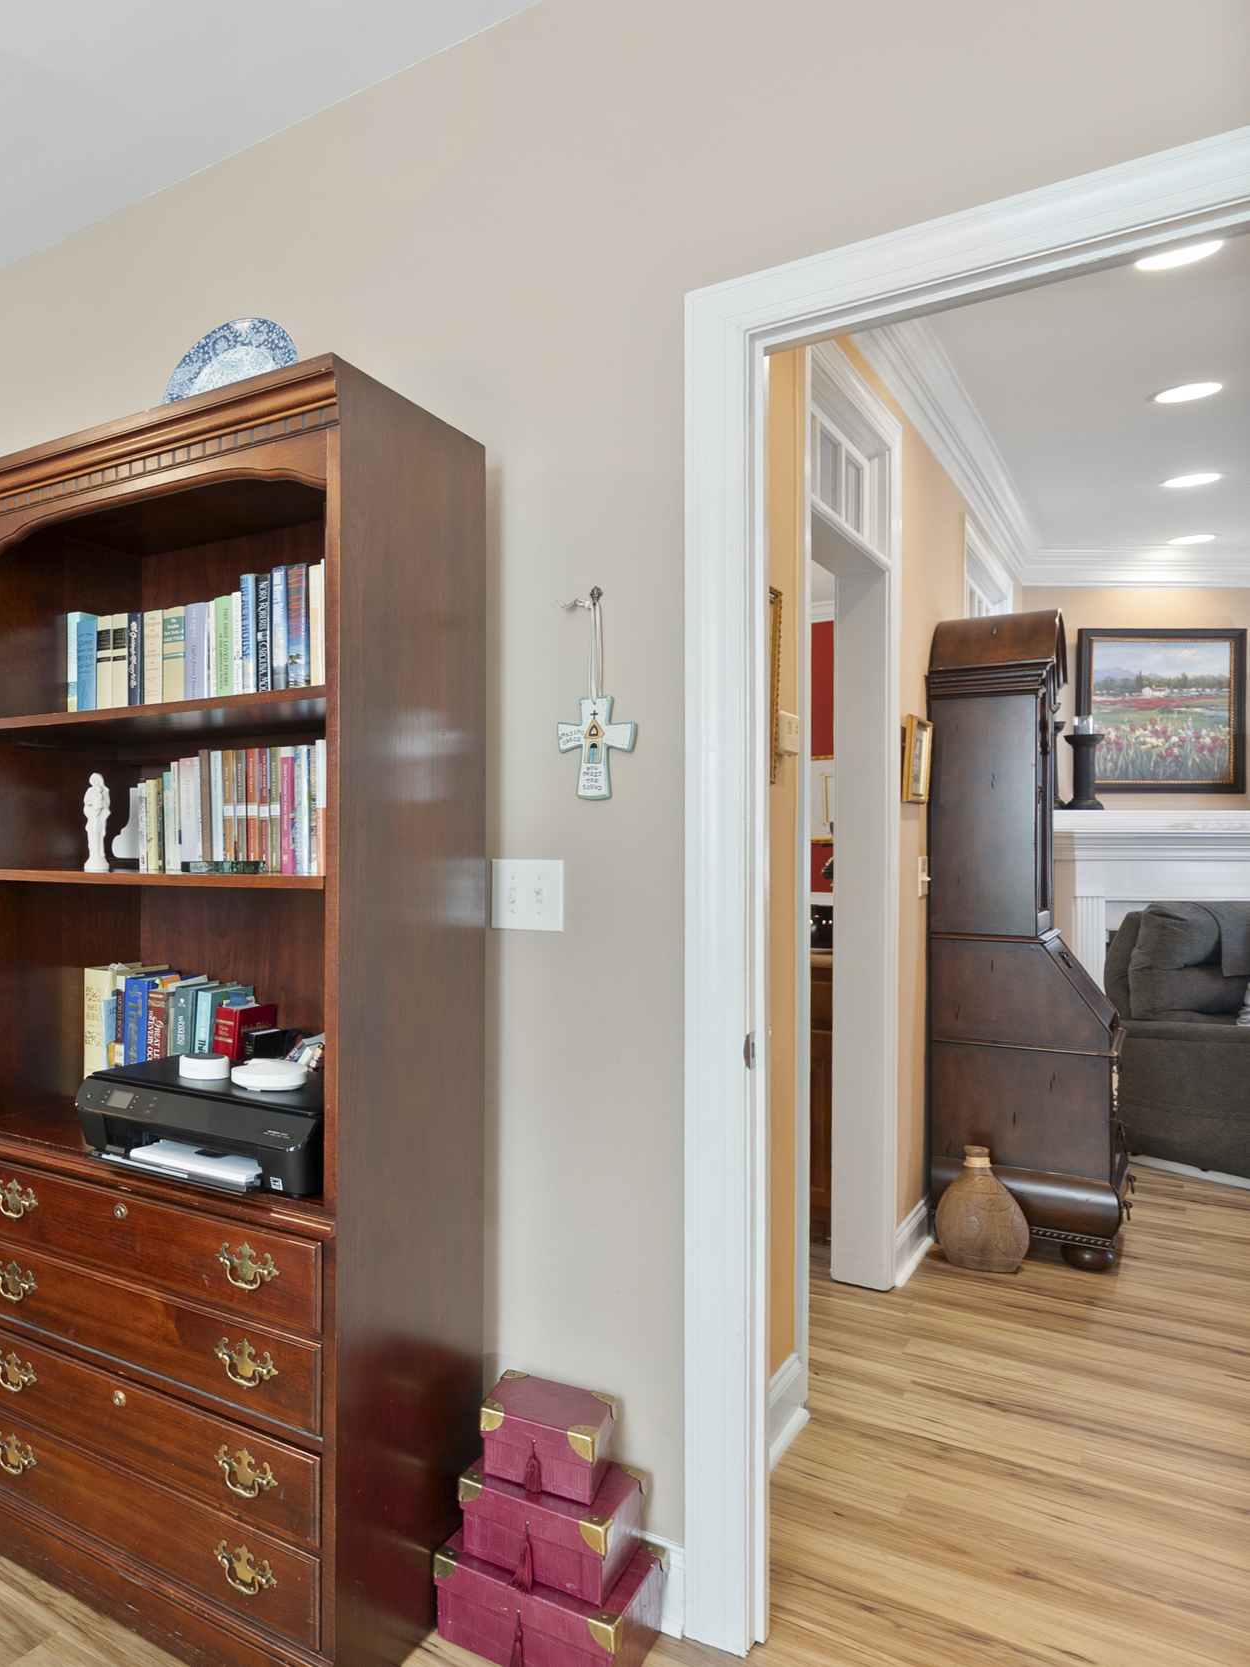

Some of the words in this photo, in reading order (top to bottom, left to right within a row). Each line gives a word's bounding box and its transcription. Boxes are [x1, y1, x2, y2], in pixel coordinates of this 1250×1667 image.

[288, 568, 307, 588] PAT
[241, 586, 253, 622] BEACH
[259, 581, 269, 602] NORA
[273, 585, 284, 602] Rivers
[257, 602, 269, 630] ROBERTS
[289, 594, 307, 638] CONROY
[241, 623, 253, 660] HOUSE
[258, 641, 269, 674] CAROLINA
[559, 729, 585, 740] AMAZING
[562, 737, 582, 746] GRACE
[184, 796, 192, 820] colors
[147, 1020, 155, 1045] EVERY
[152, 1016, 164, 1048] GREAT
[176, 1015, 186, 1046] WOMEN
